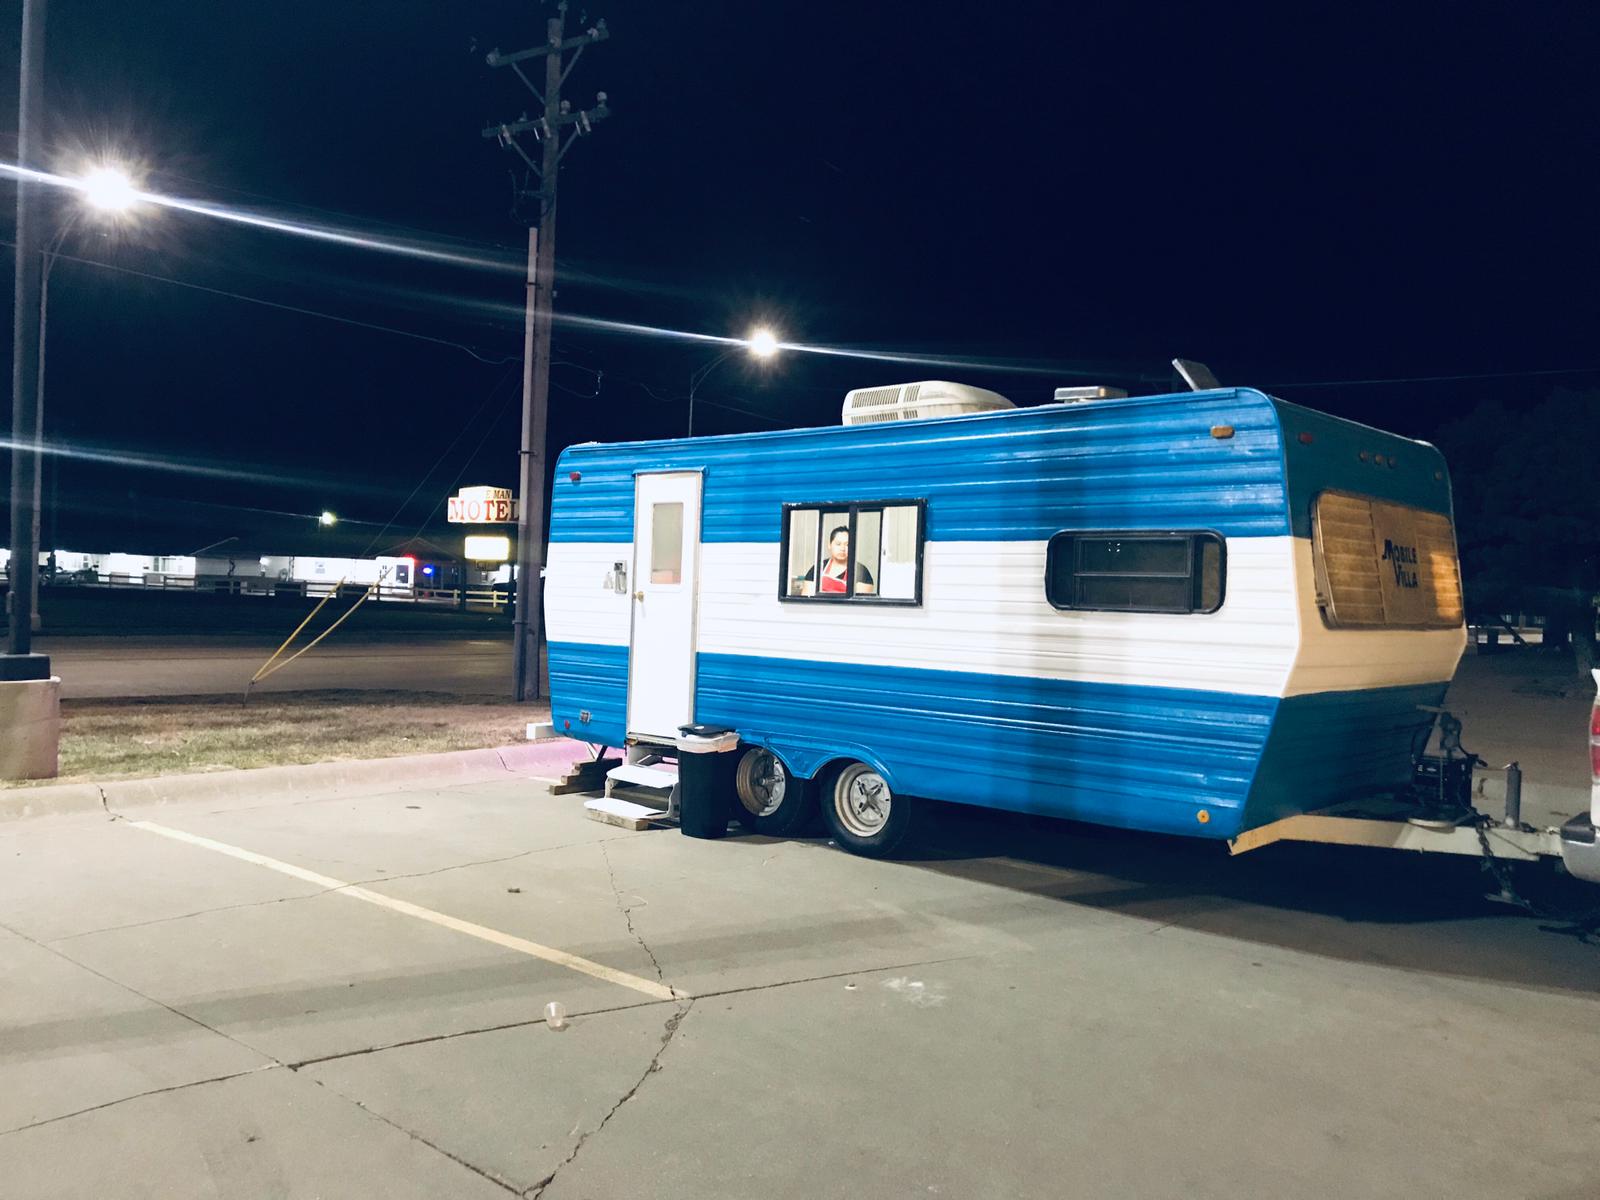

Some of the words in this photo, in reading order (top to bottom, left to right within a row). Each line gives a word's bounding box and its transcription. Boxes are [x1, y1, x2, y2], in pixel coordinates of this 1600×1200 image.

[449, 500, 520, 521] MOTEL
[1382, 539, 1417, 564] MOBILE
[1393, 564, 1418, 588] VILLA
